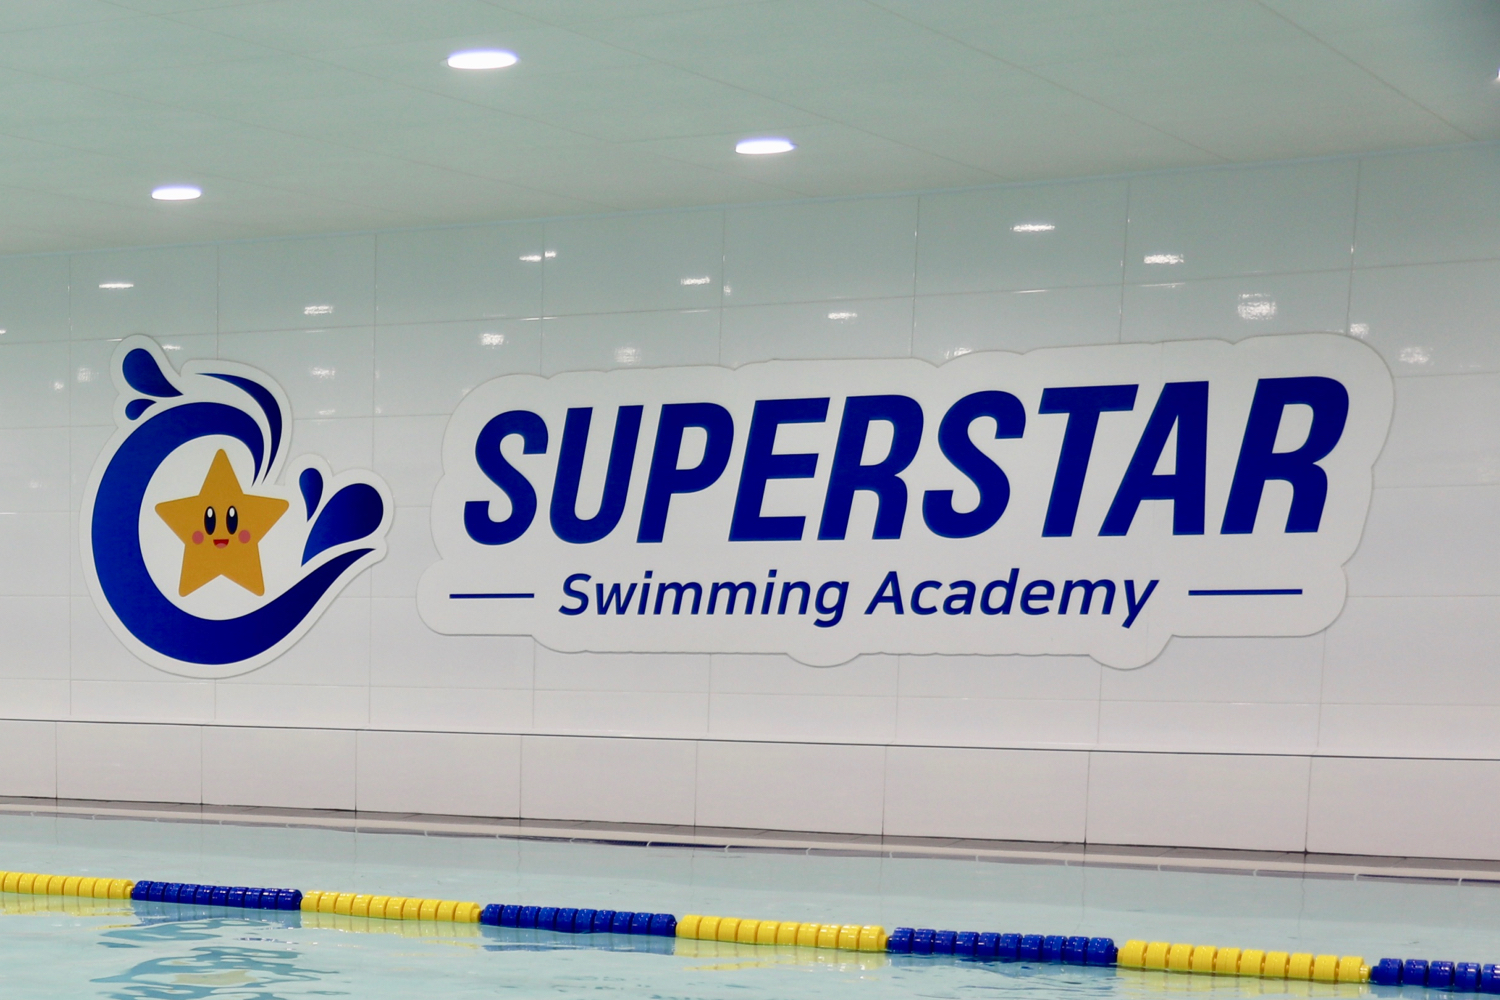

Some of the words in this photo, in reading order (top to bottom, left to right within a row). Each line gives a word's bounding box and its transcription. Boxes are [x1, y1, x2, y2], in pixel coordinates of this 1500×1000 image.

[464, 376, 1349, 546] SUPERSTAR
[559, 571, 849, 629] Swimming
[864, 567, 1159, 629] Academy
